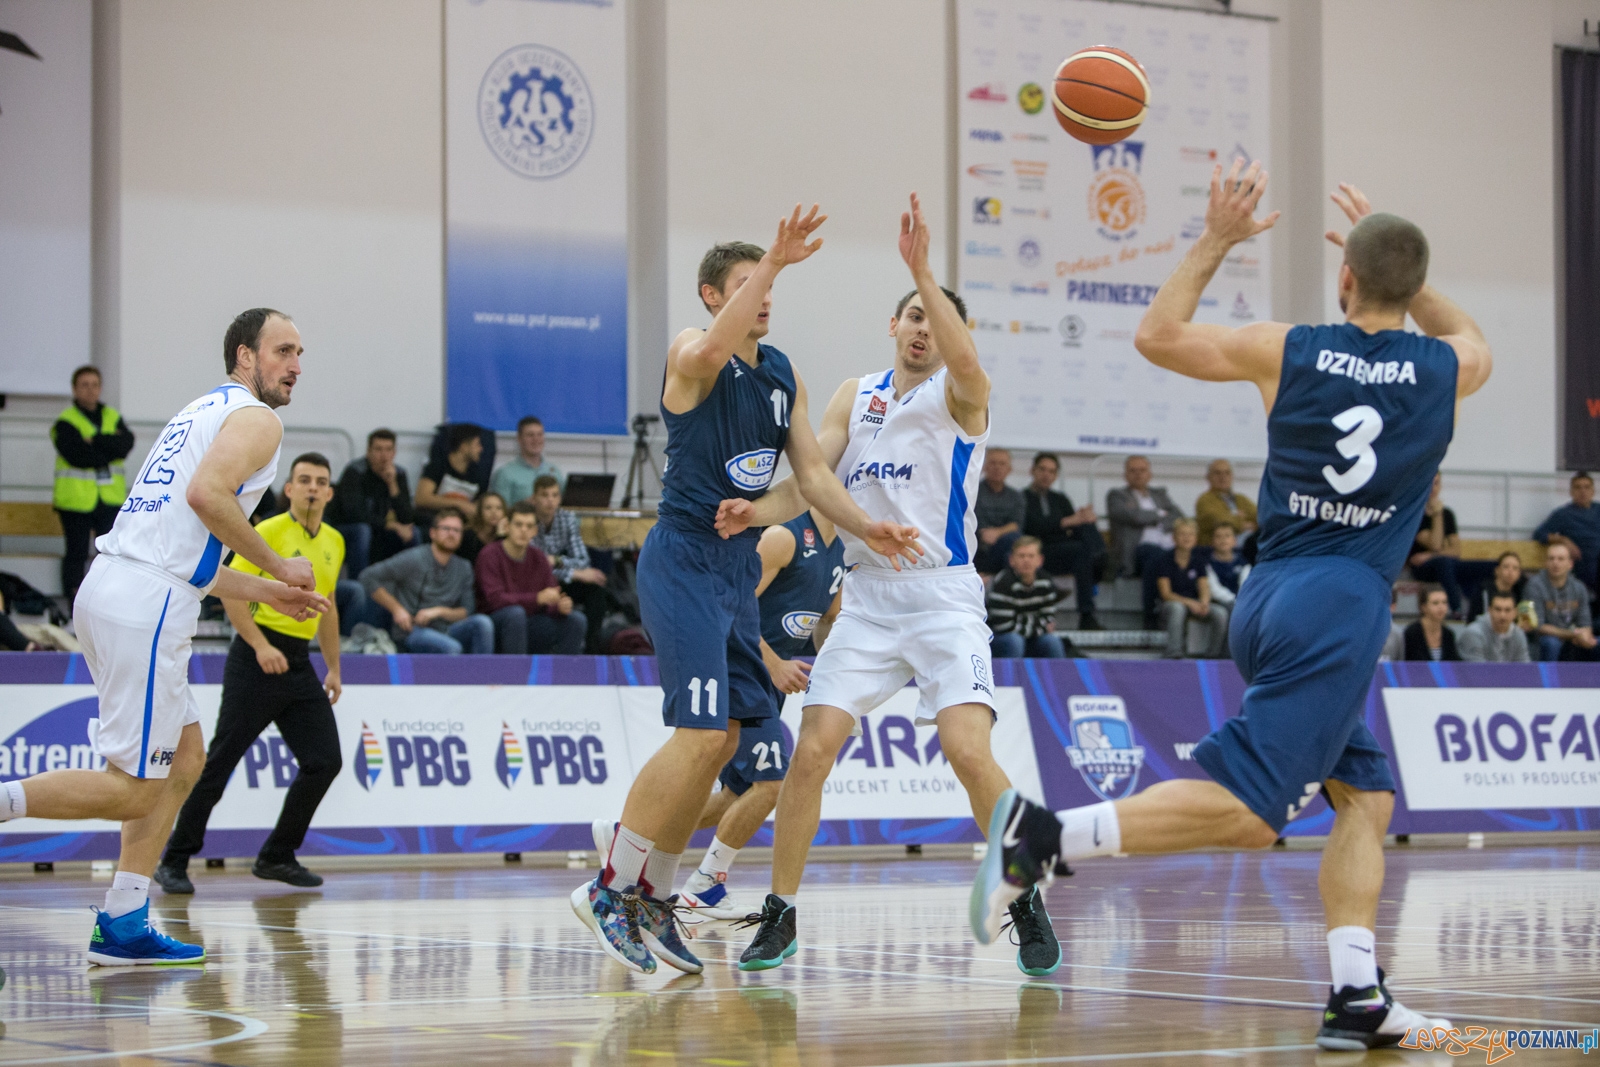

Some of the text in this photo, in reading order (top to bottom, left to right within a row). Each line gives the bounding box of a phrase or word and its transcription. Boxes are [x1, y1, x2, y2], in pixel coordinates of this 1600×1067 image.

[1316, 349, 1417, 386] DZIEMBA
[1321, 404, 1384, 495] 3
[1289, 491, 1320, 520] GTK
[688, 677, 718, 716] 11
[382, 718, 465, 735] fundacja
[522, 718, 601, 733] fundacja
[1435, 711, 1600, 762] BIOFA
[244, 735, 300, 788] PB
[386, 735, 471, 787] PBG
[525, 734, 608, 785] PBG
[752, 741, 782, 771] 21
[1072, 747, 1143, 768] BASKET
[823, 777, 956, 794] DUCENT LEKÓW
[1464, 772, 1515, 785] POLSKI
